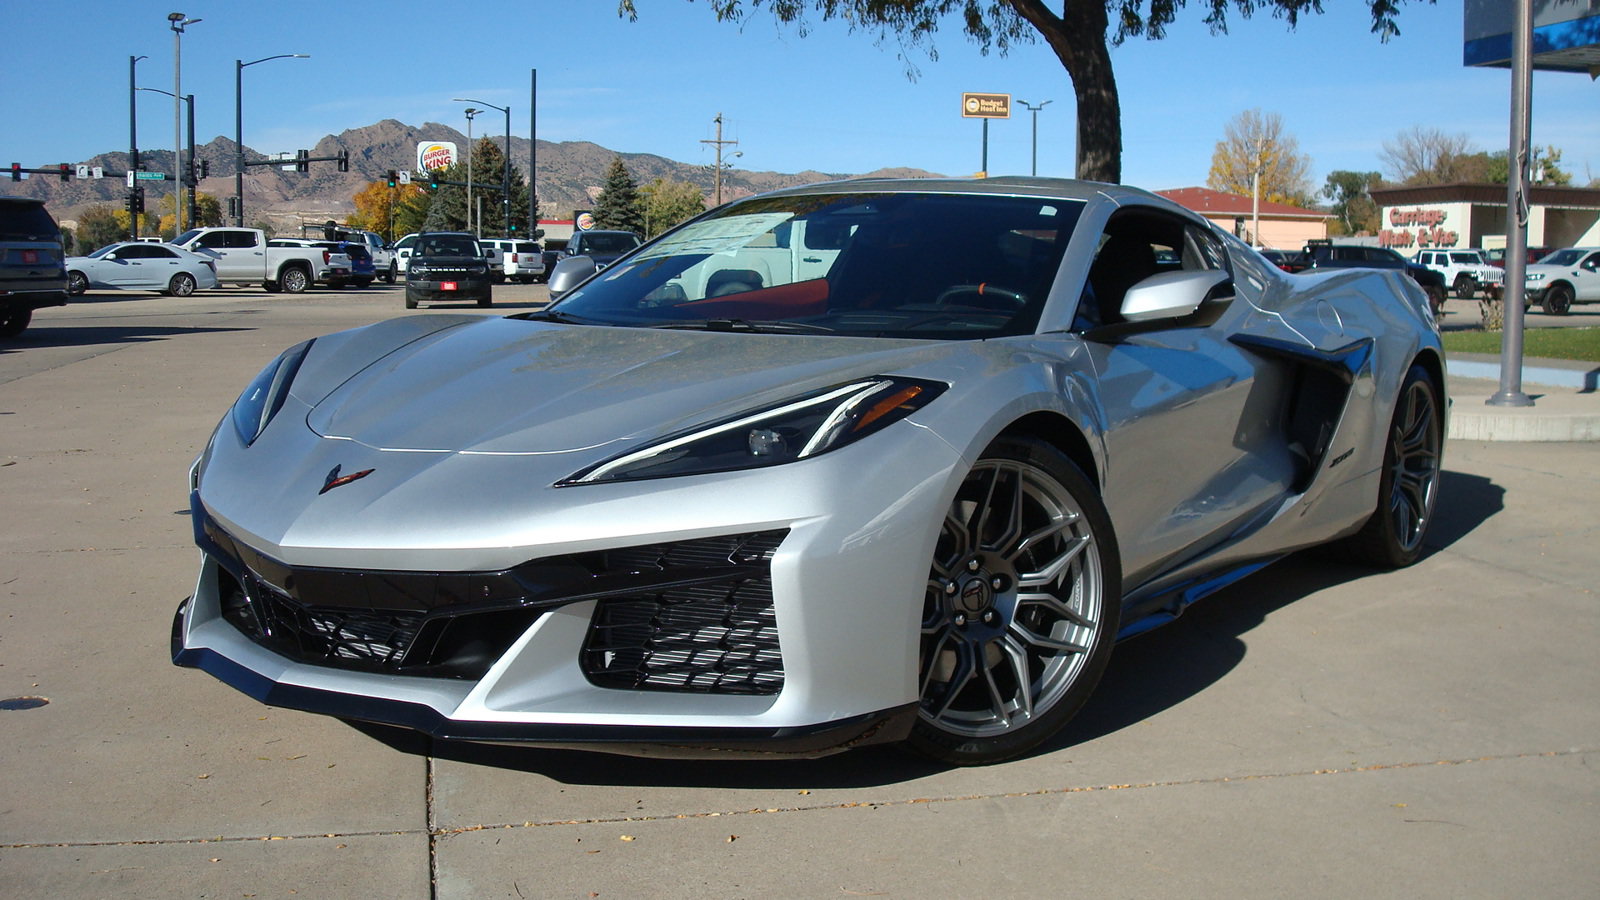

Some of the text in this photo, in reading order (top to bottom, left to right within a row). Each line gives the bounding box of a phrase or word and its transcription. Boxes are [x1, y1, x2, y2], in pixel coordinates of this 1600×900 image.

[980, 99, 1003, 107] Budget
[423, 149, 450, 161] BURGER
[425, 156, 452, 169] KING
[1390, 207, 1447, 230] Carriage
[1377, 226, 1459, 248] Wash & Vac
